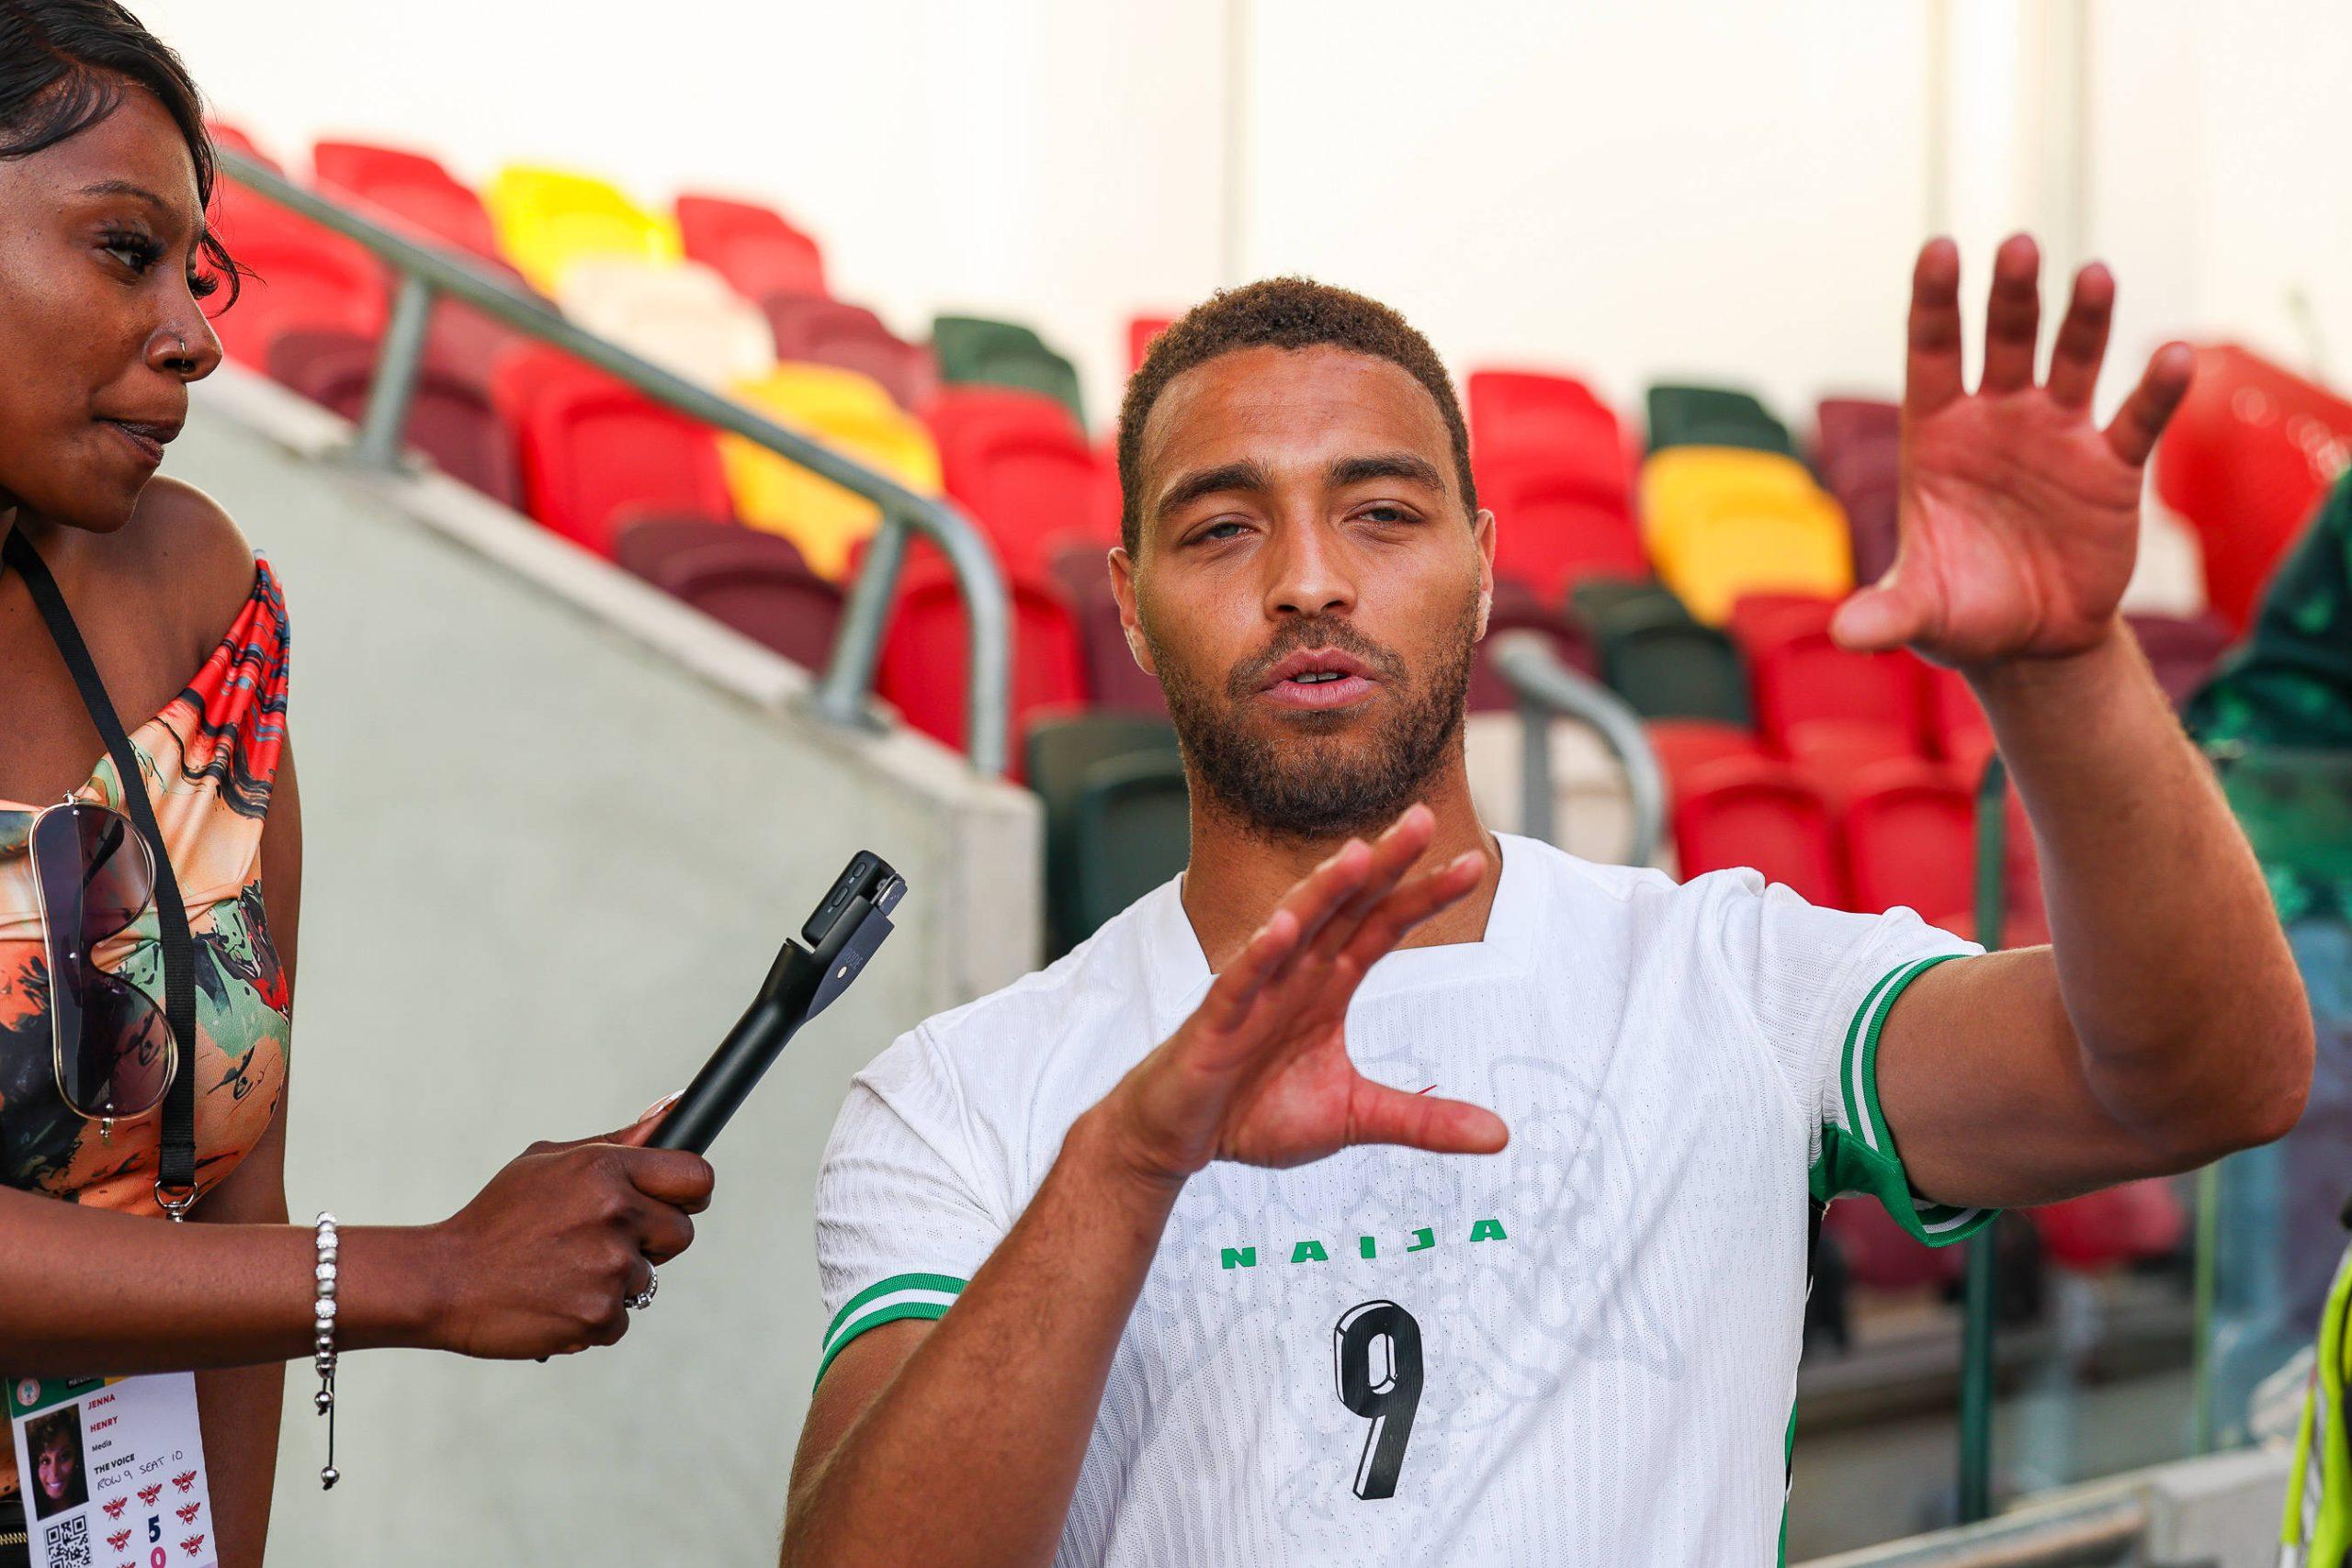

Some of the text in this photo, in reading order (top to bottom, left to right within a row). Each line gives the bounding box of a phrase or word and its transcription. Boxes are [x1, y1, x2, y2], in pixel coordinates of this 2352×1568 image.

[1221, 1219, 1508, 1269] NAIJA
[88, 1393, 116, 1410] JENNA
[1334, 1299, 1424, 1500] 9
[90, 1416, 119, 1433] HENRY
[92, 1439, 112, 1451] Media
[94, 1453, 135, 1475] THE VOICE
[97, 1450, 183, 1491] ROW 9 SEAT 10
